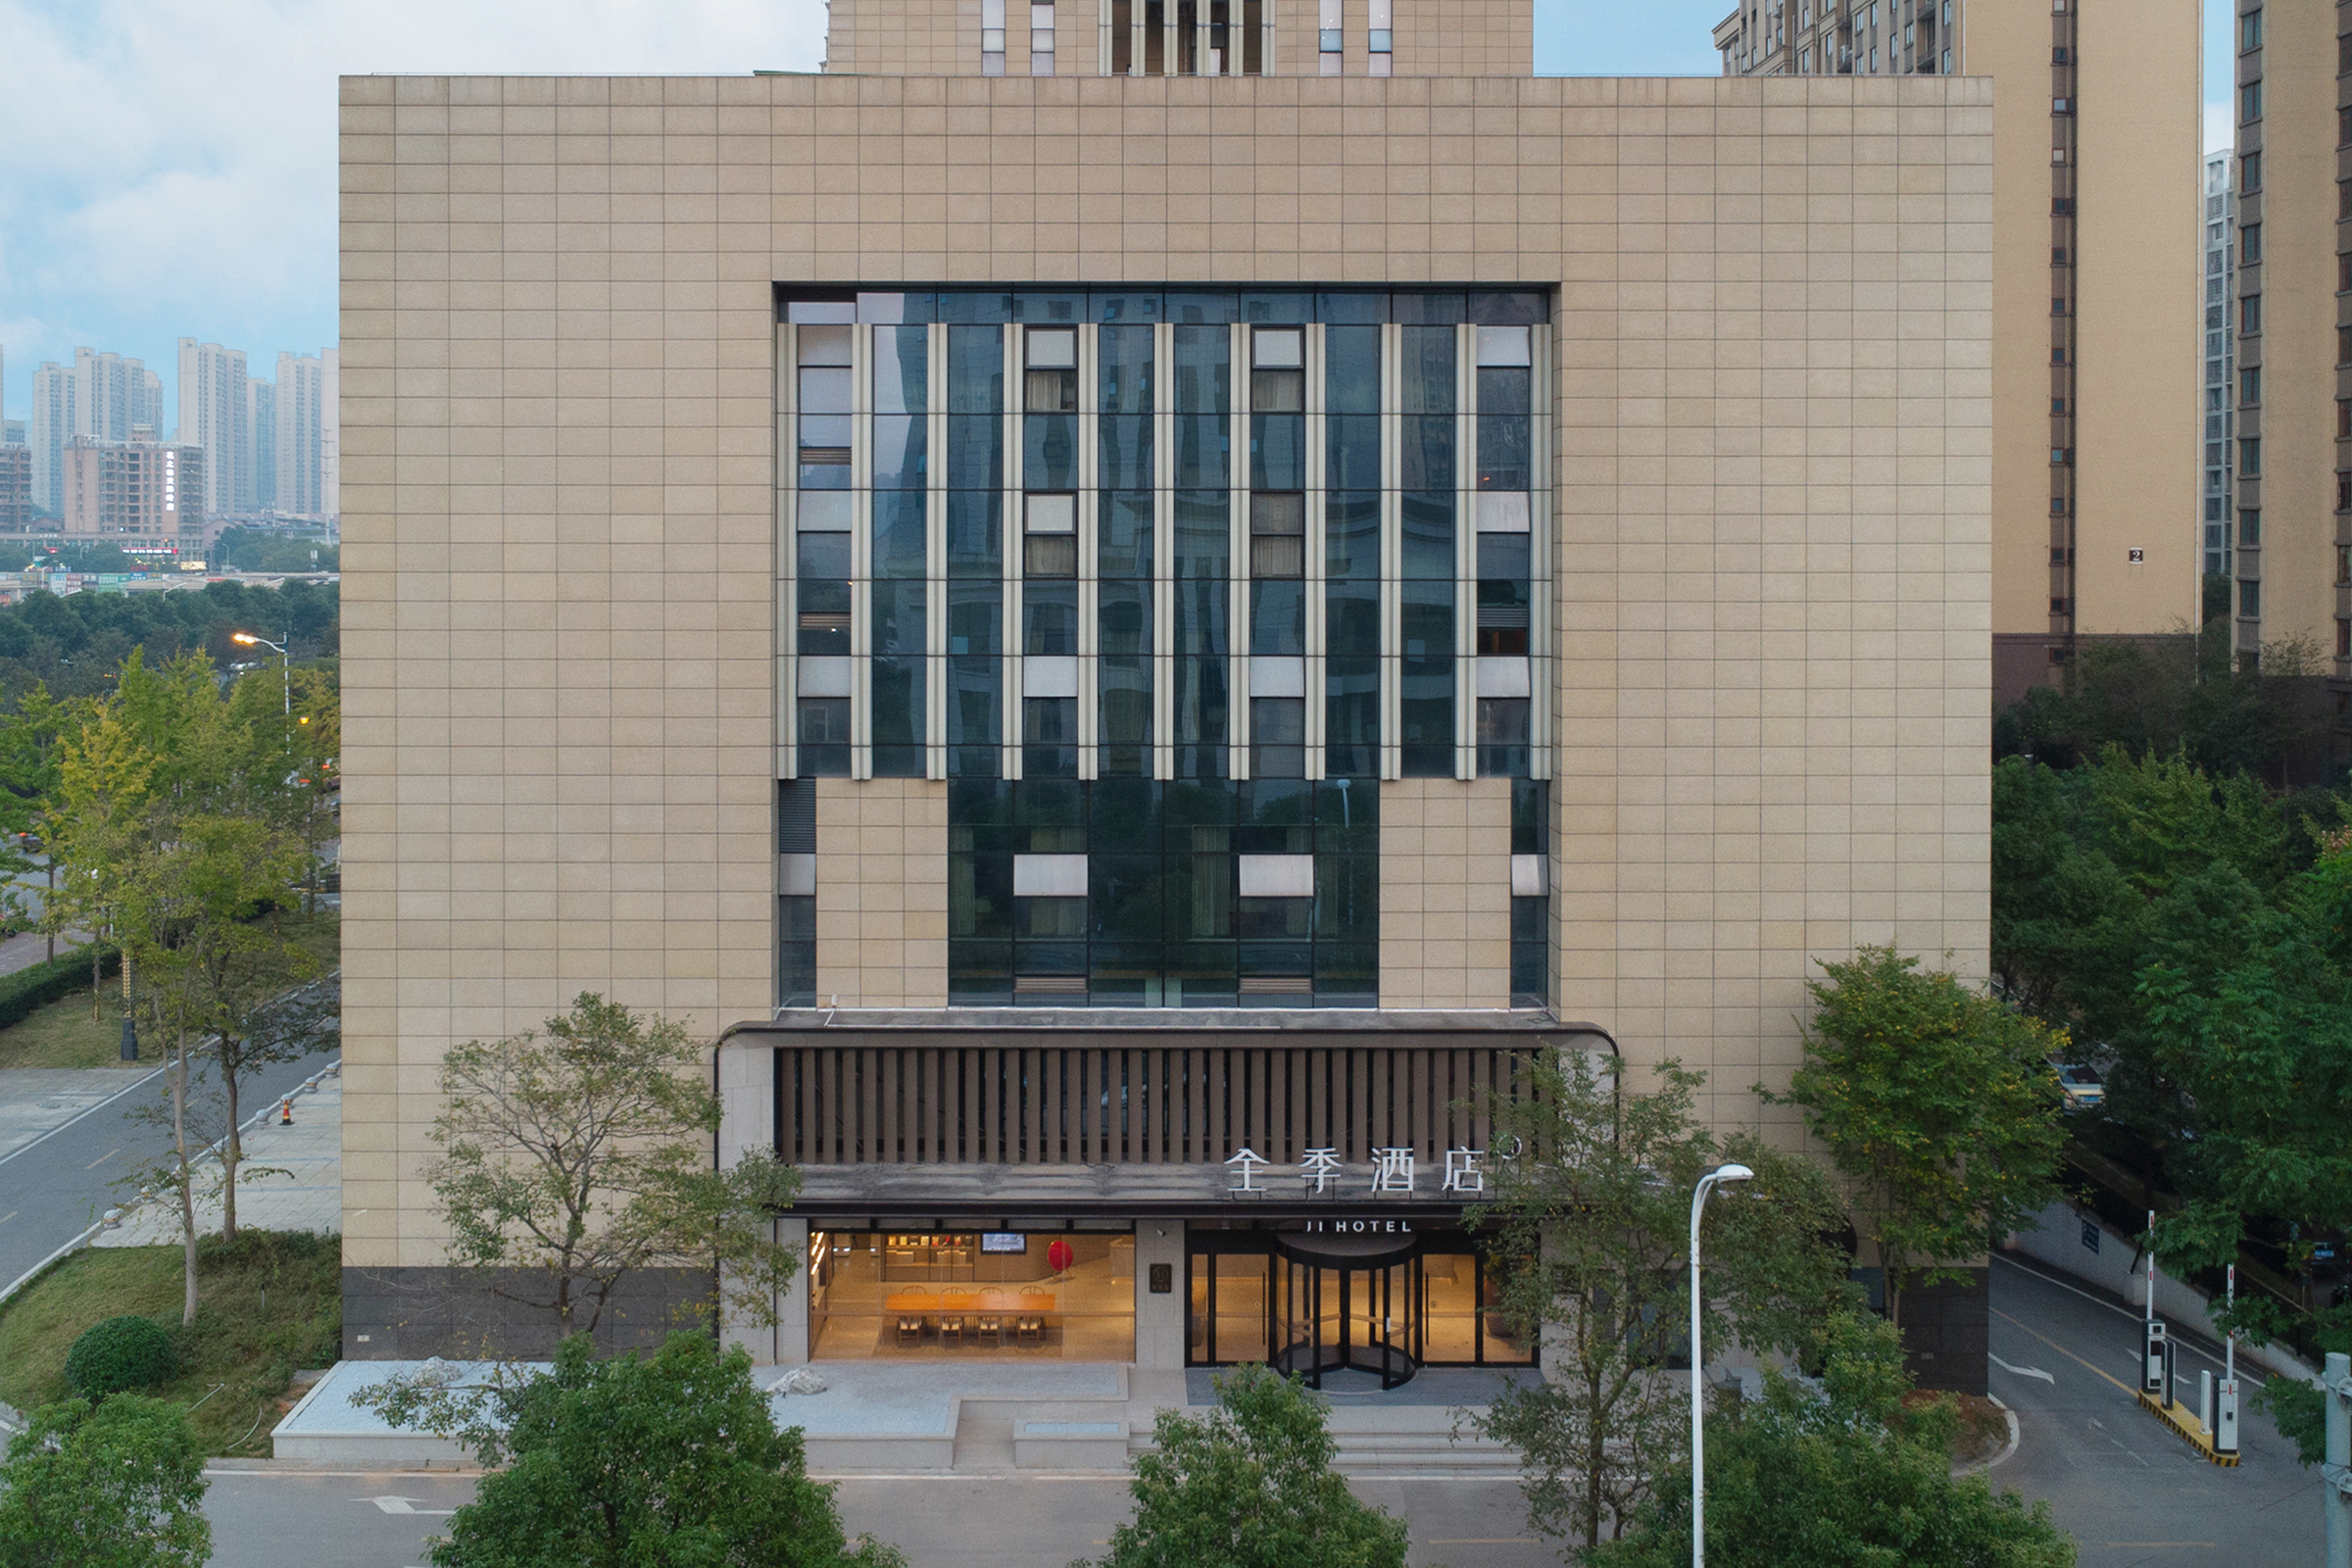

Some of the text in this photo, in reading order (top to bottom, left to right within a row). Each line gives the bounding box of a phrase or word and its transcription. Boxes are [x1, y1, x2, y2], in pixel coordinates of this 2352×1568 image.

[2132, 550, 2140, 562] 2
[1224, 1146, 1485, 1194] 全季酒店
[1306, 1220, 1411, 1233] JI HOTEL
